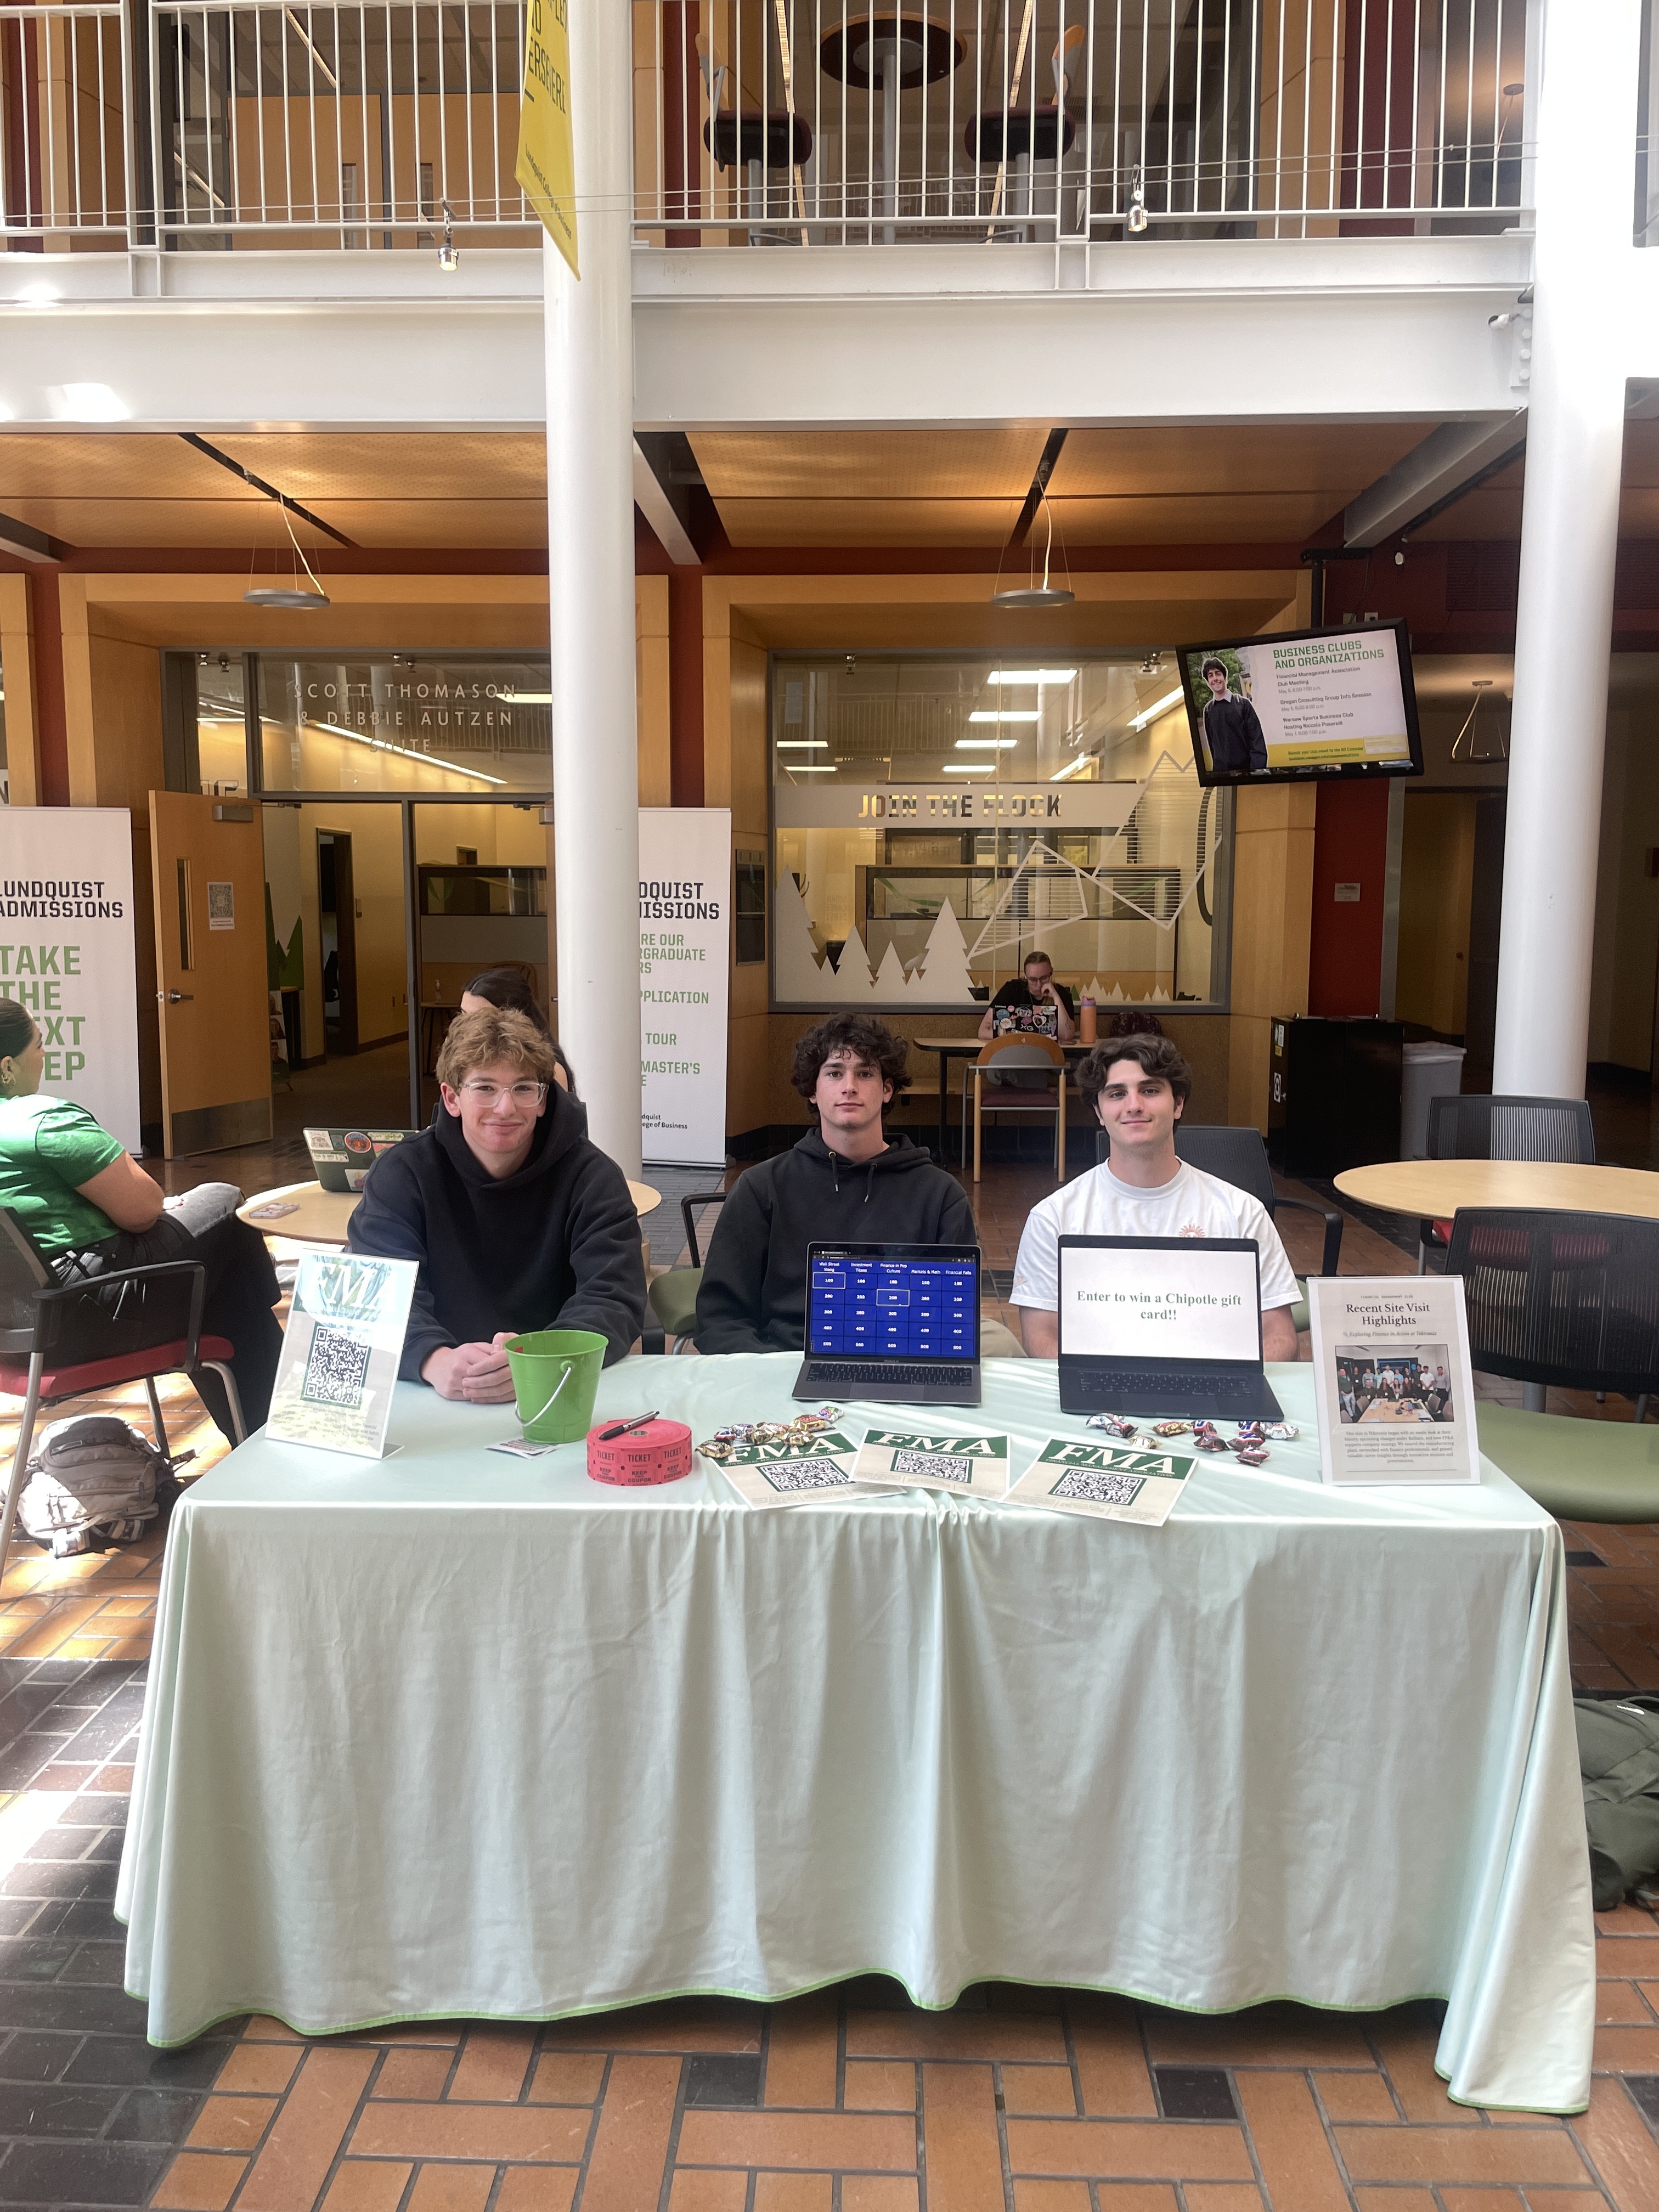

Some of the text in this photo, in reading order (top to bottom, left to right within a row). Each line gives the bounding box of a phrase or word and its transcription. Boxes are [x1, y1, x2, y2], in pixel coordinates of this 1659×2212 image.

[1273, 640, 1362, 658] BUSINESS CLUBS
[1275, 649, 1384, 669] AND ORGANIZATIONS
[295, 683, 515, 698] SCOTT THOMASON
[301, 711, 512, 726] & DEBBIE AUTZEN
[370, 738, 431, 753] SUITE
[858, 794, 1062, 817] JOIN THE FLOCK
[0, 881, 105, 900] UNDQUIST
[639, 882, 704, 901] DQUIST
[640, 901, 719, 919] ISSIONS
[660, 934, 684, 946] OUR
[0, 945, 81, 975] TAKE
[0, 981, 61, 1010] THE
[645, 1032, 677, 1045] TOUR
[44, 1052, 85, 1080] EP
[1077, 1291, 1110, 1301] Enter
[1115, 1293, 1125, 1302] to
[1130, 1293, 1151, 1302] win
[1165, 1293, 1217, 1307] Chipotle
[1221, 1295, 1242, 1307] gift
[1141, 1310, 1176, 1320] card!!
[1346, 1303, 1430, 1313] Recent Site Visit
[1362, 1316, 1416, 1327] Highlights
[725, 1437, 844, 1463] FMA
[873, 1432, 996, 1454] FMA
[597, 1450, 614, 1461] TICKET
[628, 1454, 651, 1462] TICKET
[664, 1447, 682, 1459] TICKET
[1047, 1443, 1176, 1475] FMA
[664, 1470, 682, 1479] COUPON
